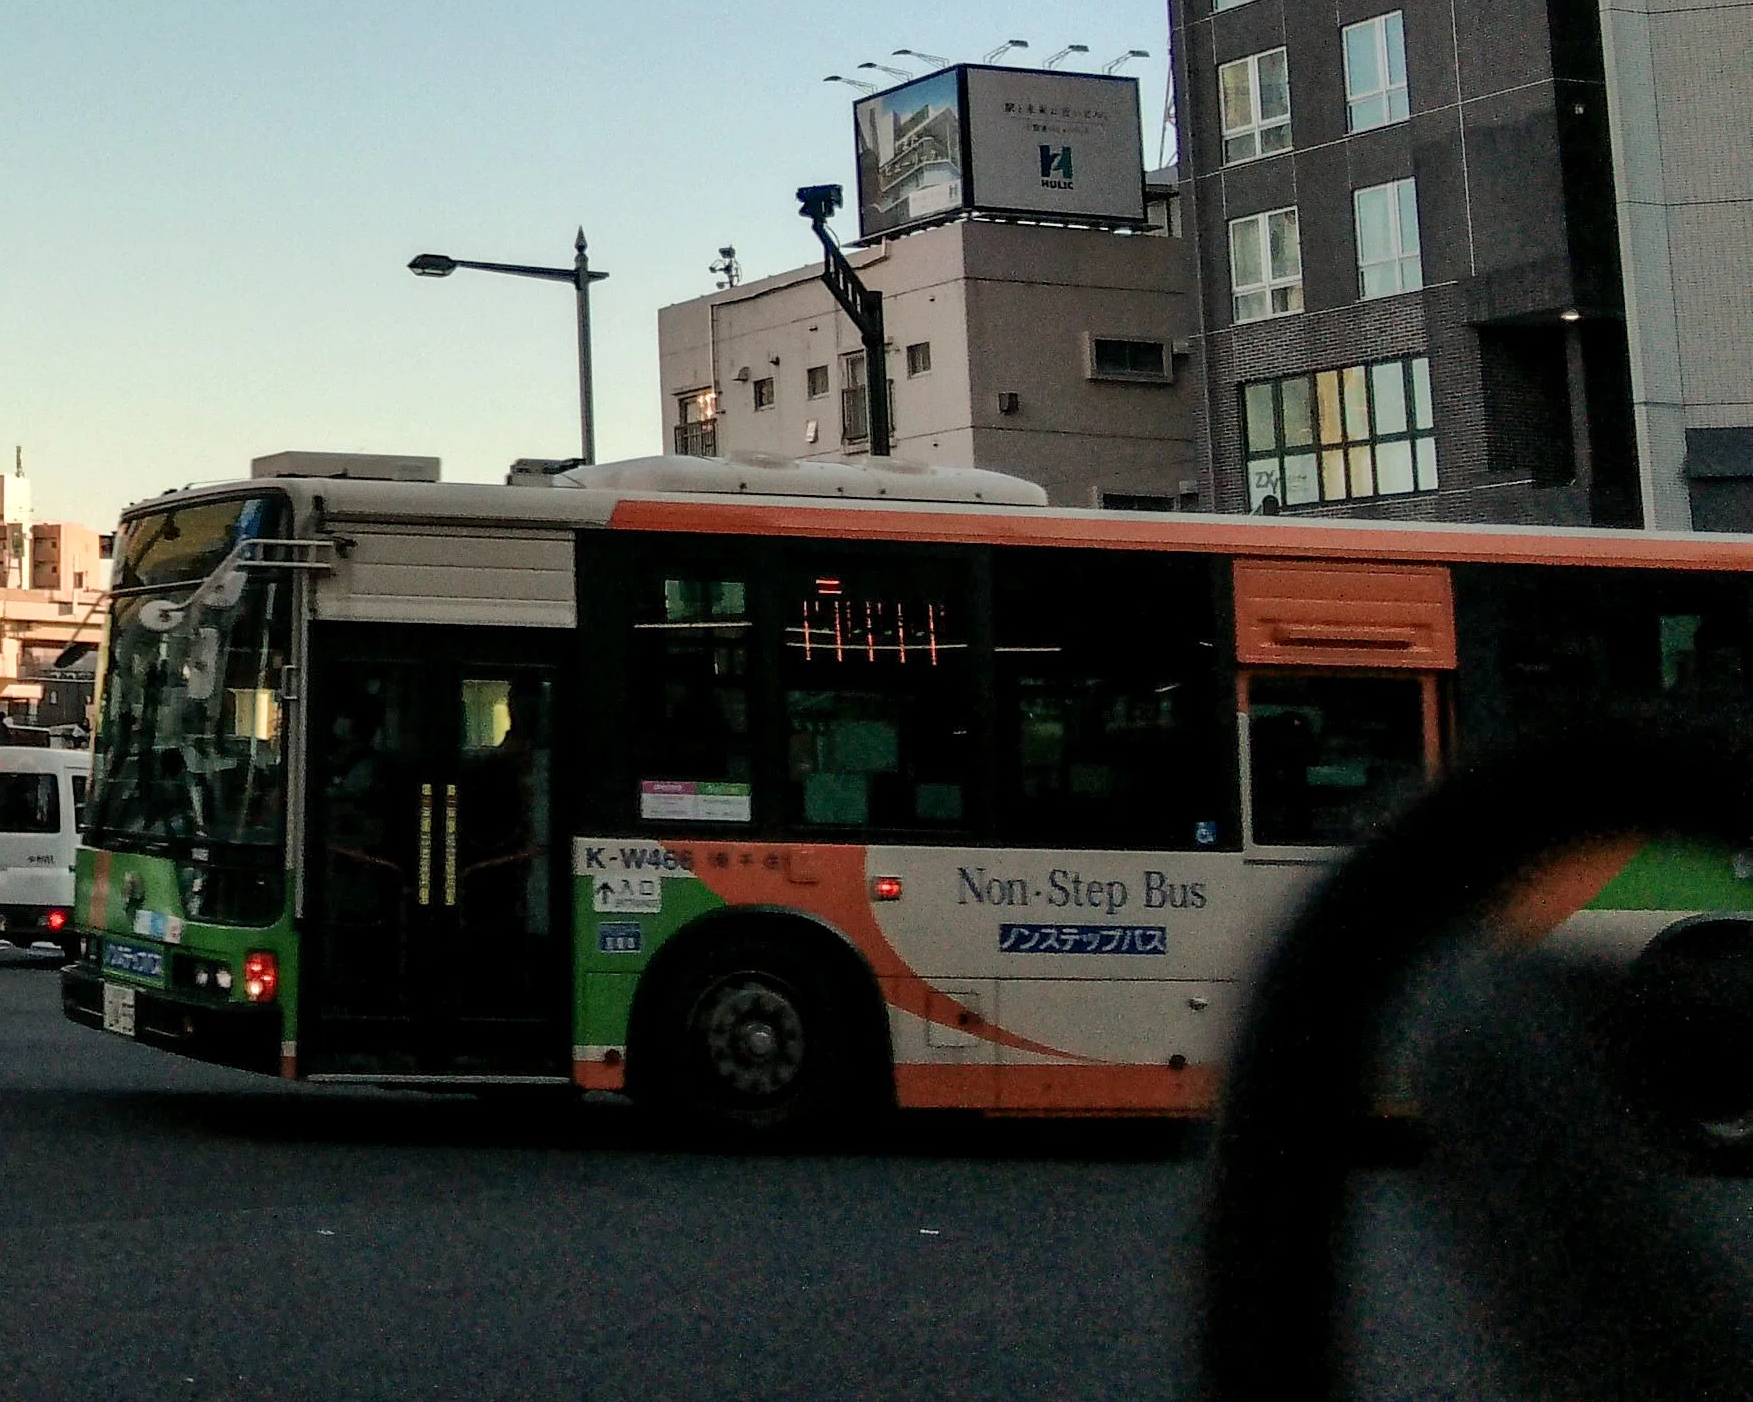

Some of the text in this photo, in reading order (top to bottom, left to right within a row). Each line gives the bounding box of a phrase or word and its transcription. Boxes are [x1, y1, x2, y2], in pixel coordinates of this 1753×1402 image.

[1041, 179, 1074, 191] HULIC
[1144, 869, 1208, 909] Bus
[1001, 927, 1166, 952] ノンステップバス
